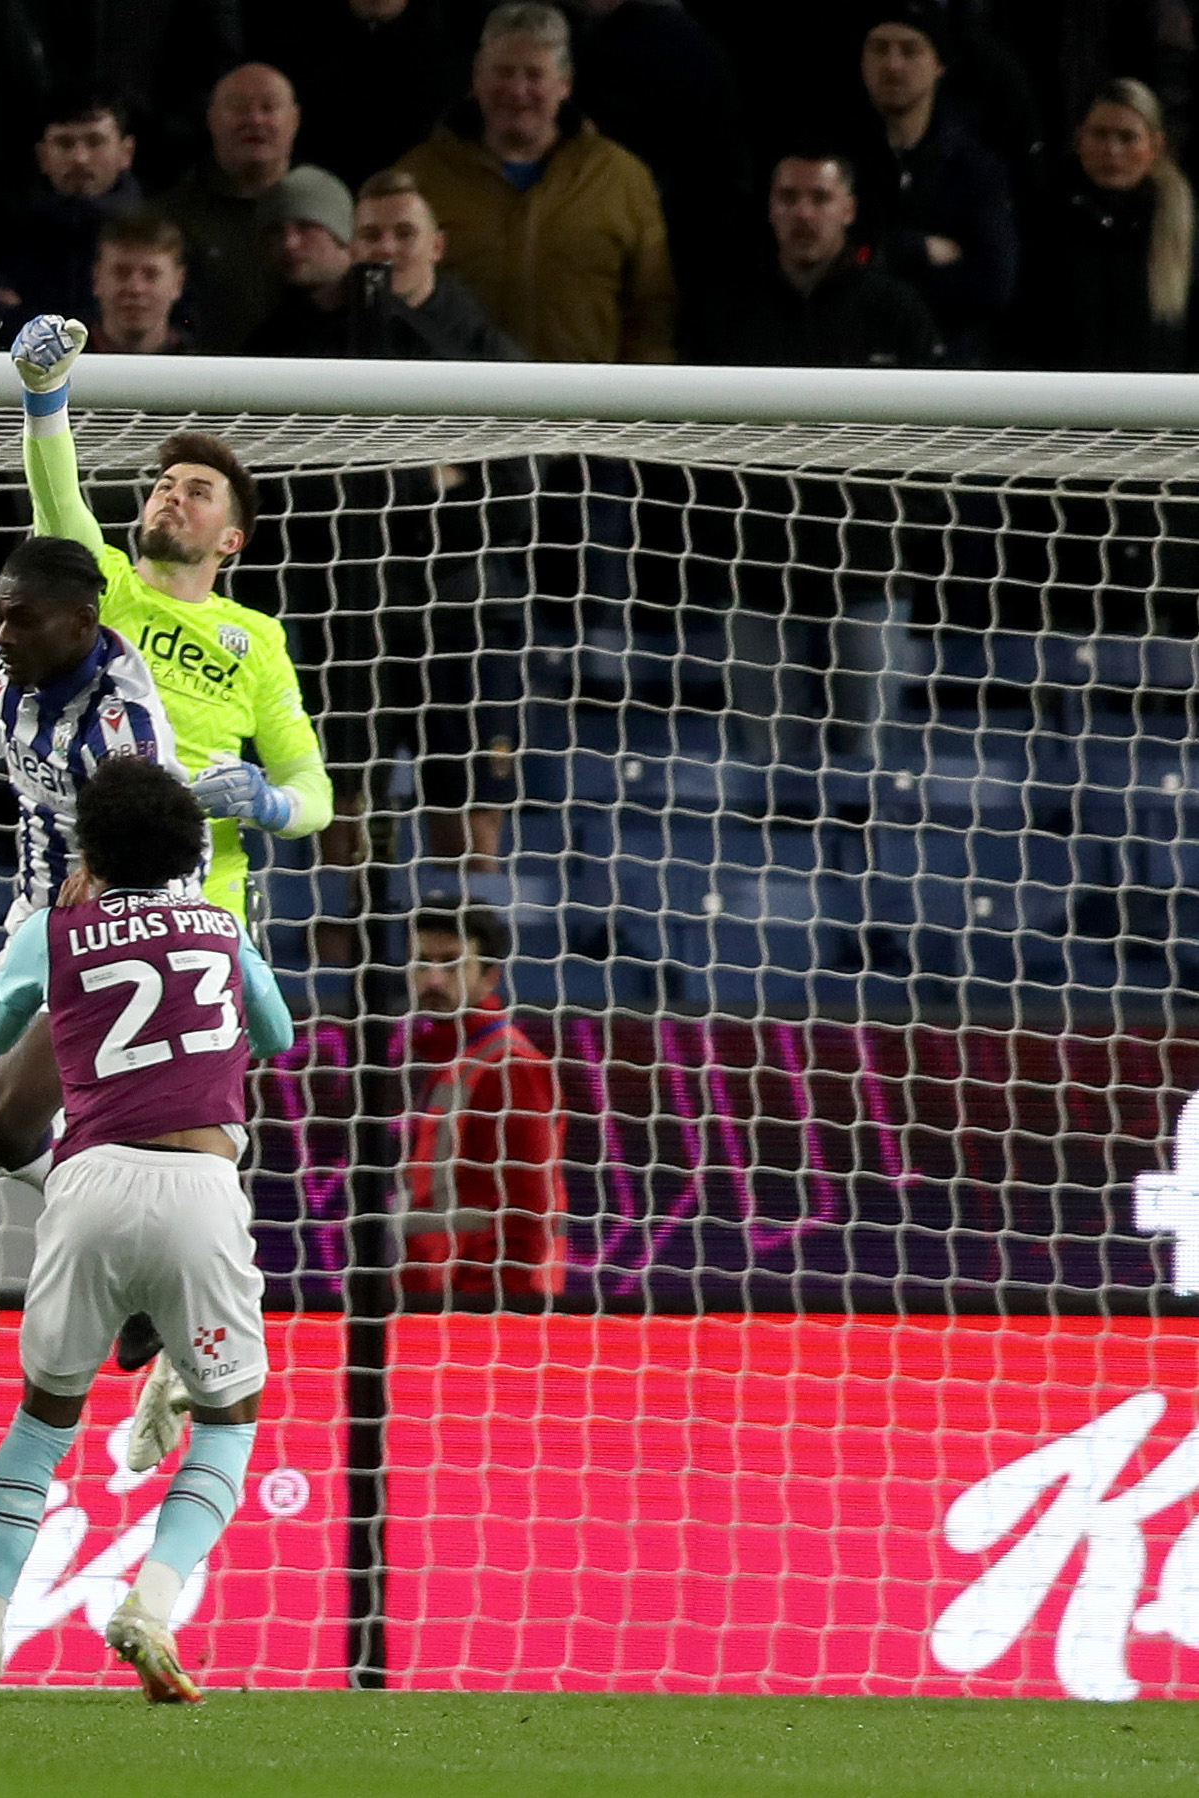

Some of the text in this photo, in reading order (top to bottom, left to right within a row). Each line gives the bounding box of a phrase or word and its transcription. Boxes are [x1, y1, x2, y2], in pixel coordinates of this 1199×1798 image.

[150, 660, 236, 701] EATING
[68, 910, 238, 956] LUCAS PIRES
[79, 949, 243, 1079] 23
